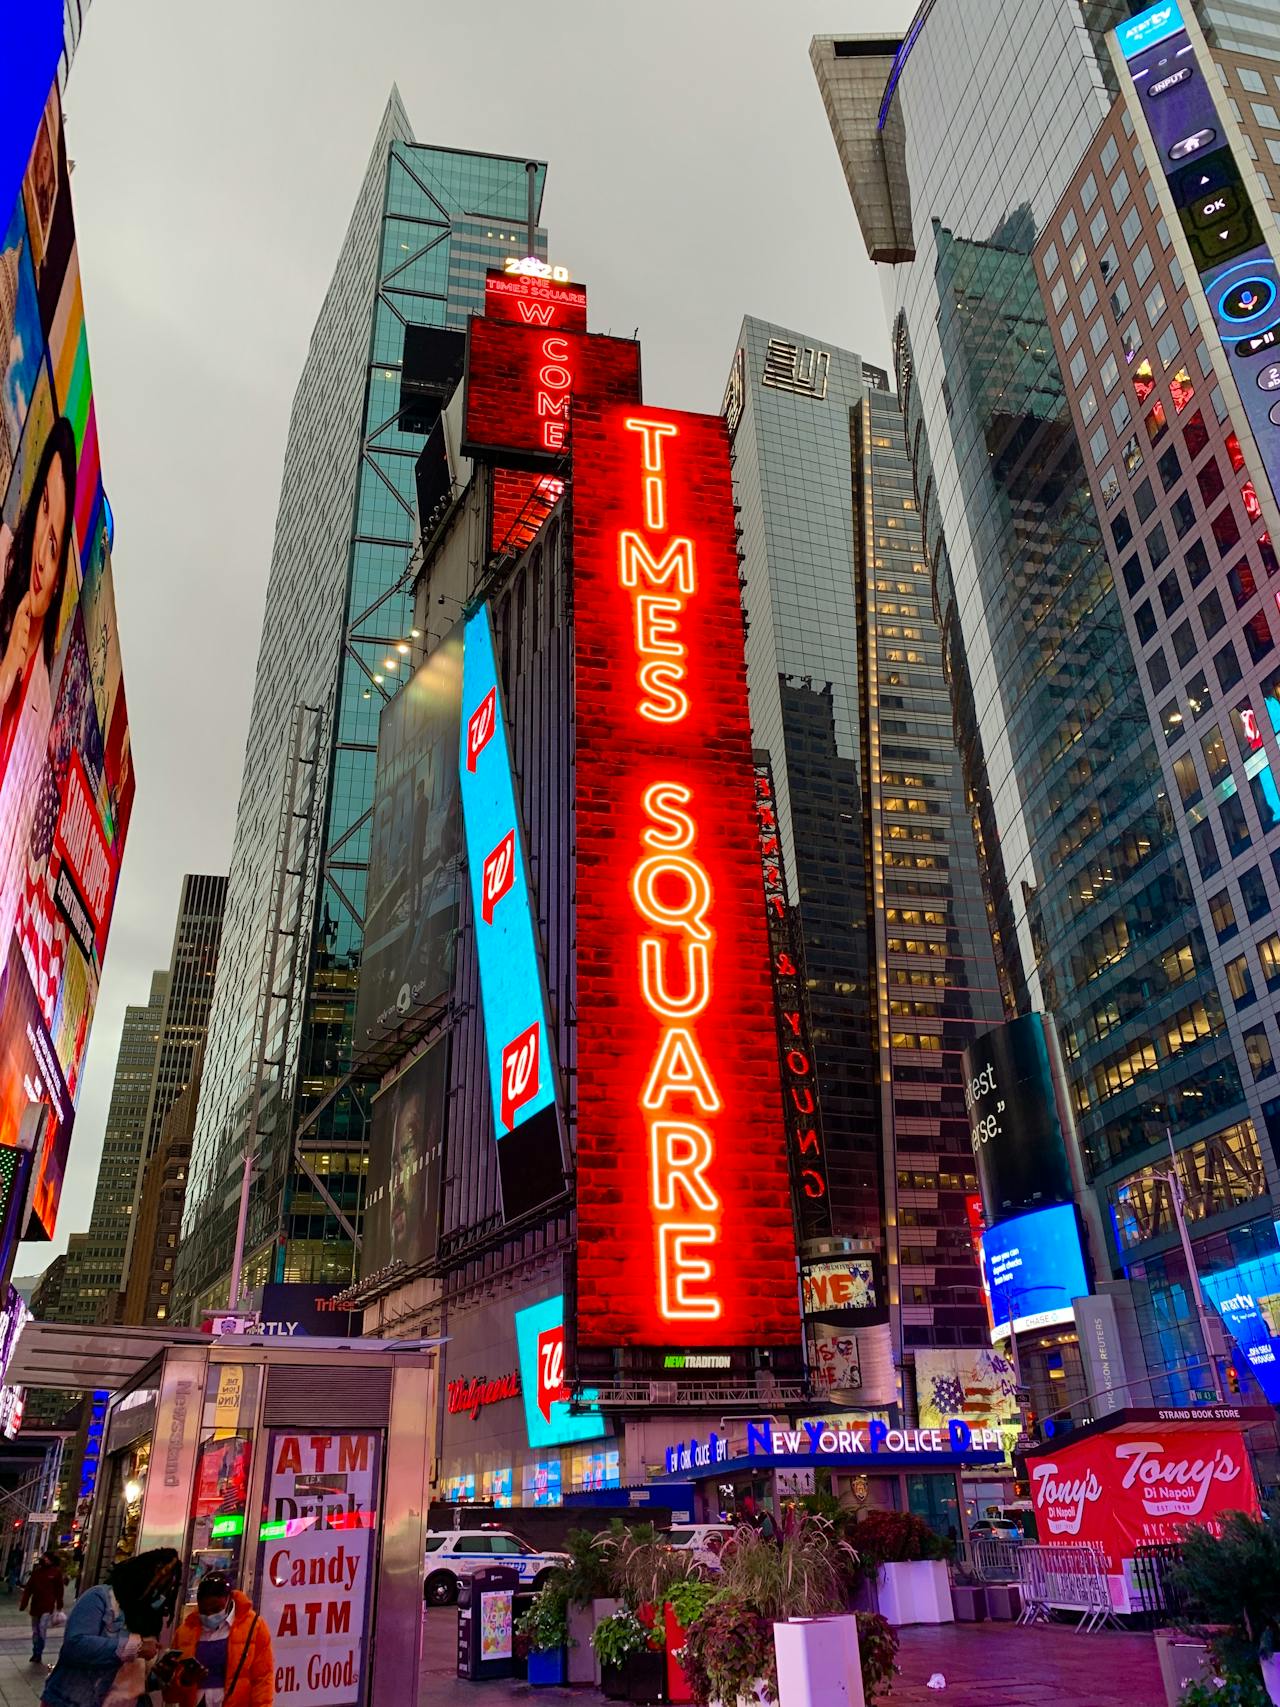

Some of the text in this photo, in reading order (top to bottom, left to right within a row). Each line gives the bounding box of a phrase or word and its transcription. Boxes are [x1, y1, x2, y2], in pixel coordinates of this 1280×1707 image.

[1154, 69, 1185, 92] INPUT
[1203, 198, 1226, 215] OK
[487, 279, 586, 305] TIMES SQUARE
[519, 275, 551, 289] ONE
[1269, 368, 1280, 380] 2
[619, 418, 695, 723] TIMES
[633, 782, 721, 1319] SQUARE
[1095, 1318, 1108, 1360] REUTERS
[448, 1372, 520, 1421] Walgreens
[1159, 1409, 1240, 1419] STRAND BOOK STORE
[276, 1435, 369, 1474] ATM
[1116, 1441, 1241, 1500] Tony's
[1033, 1463, 1103, 1520] Tony's
[1144, 1486, 1196, 1500] Di Napoli
[274, 1494, 364, 1532] Drink
[1048, 1506, 1076, 1519] Di Napoli
[270, 1546, 361, 1591] Candy
[277, 1600, 352, 1637] ATM
